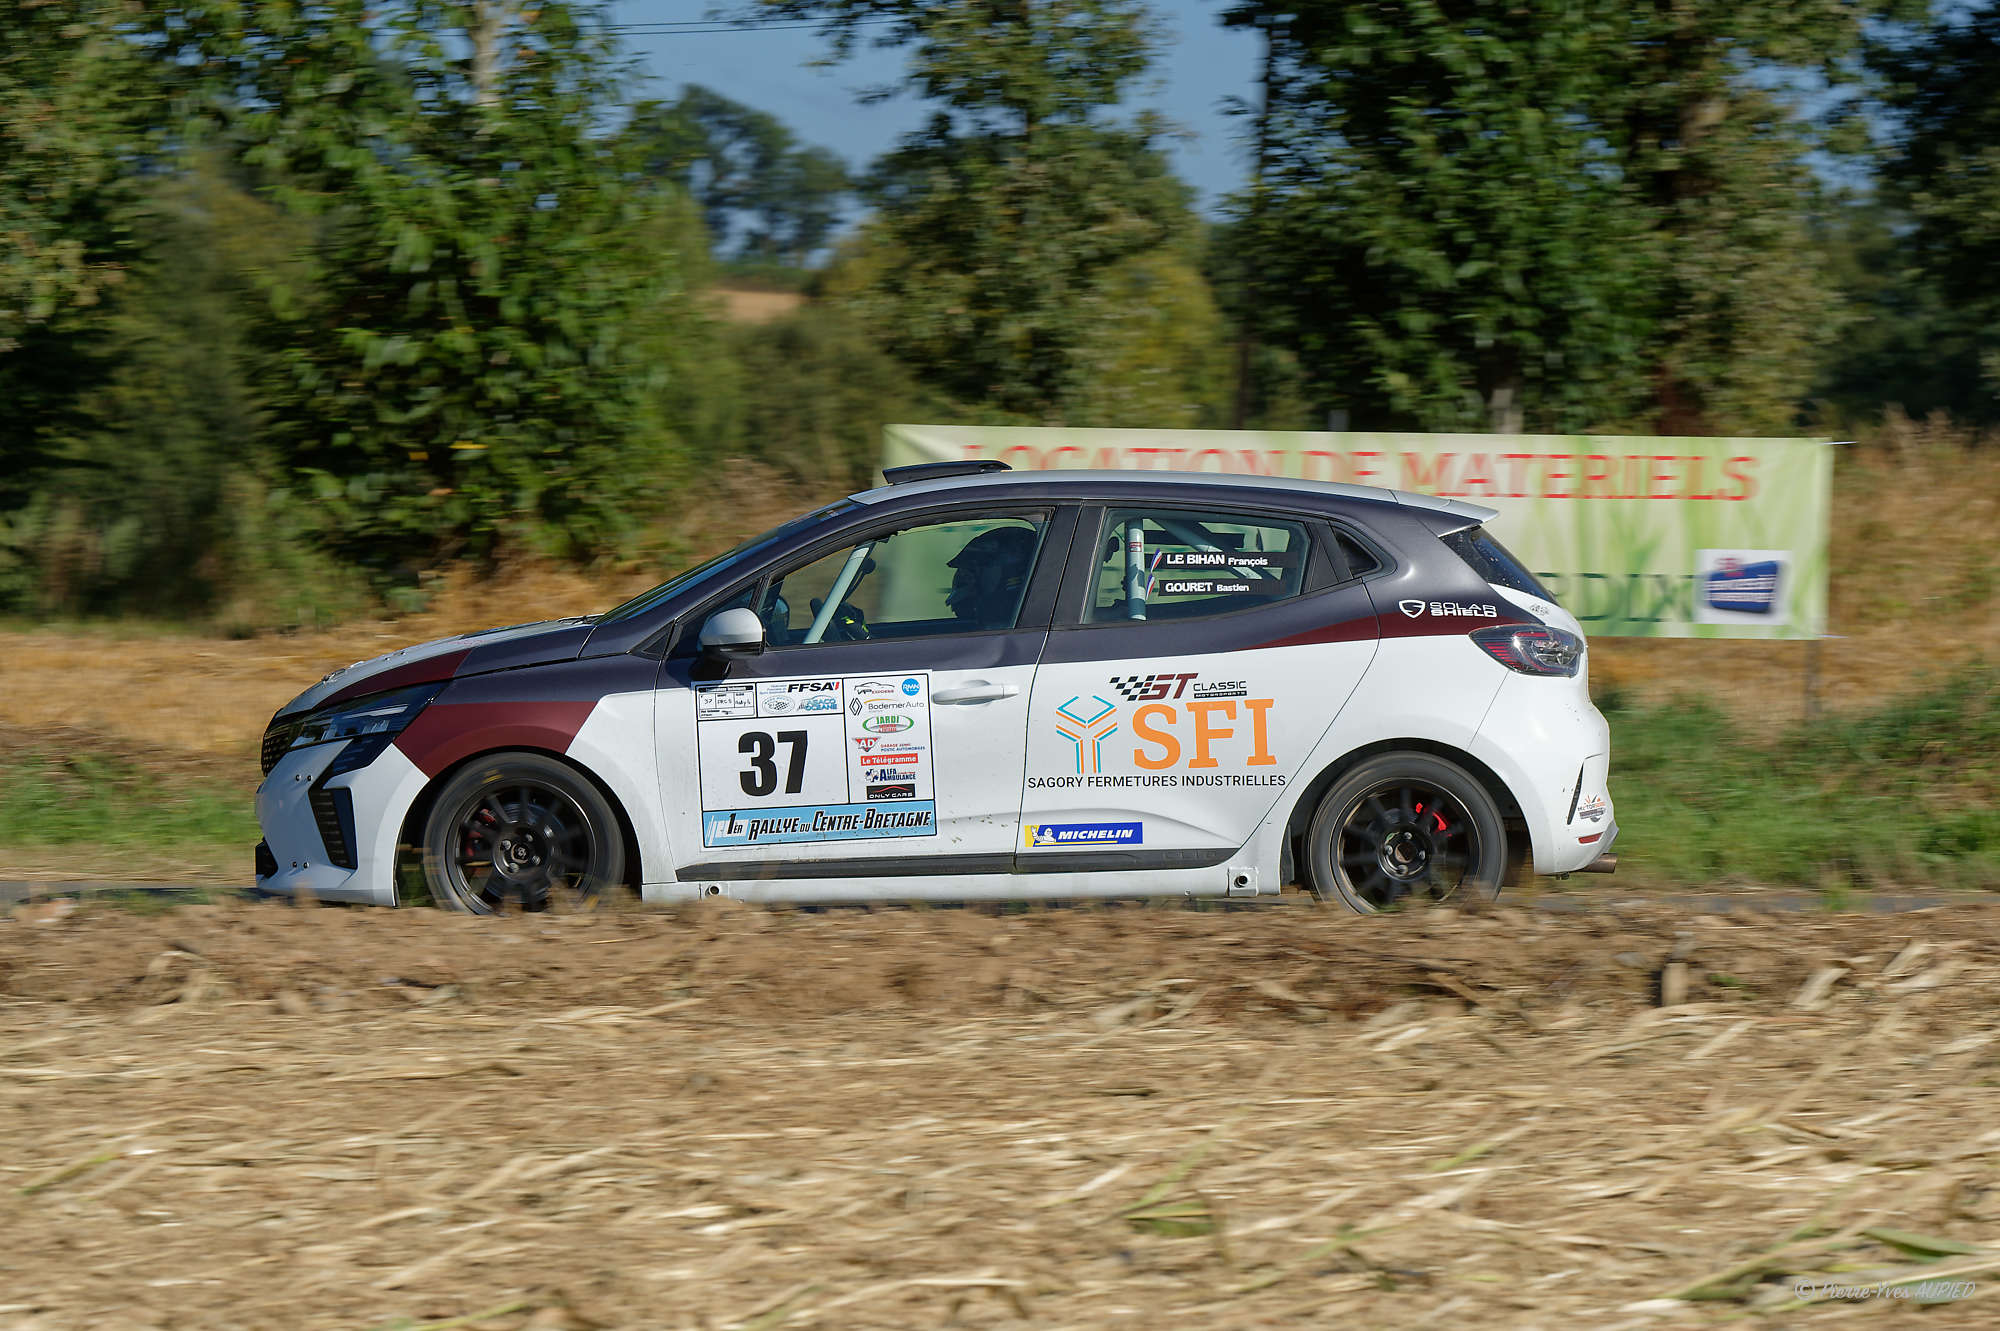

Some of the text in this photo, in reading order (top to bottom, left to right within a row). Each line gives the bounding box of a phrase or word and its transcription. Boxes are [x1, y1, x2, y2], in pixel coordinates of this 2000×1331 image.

[1302, 450, 1385, 486] DE
[1400, 452, 1759, 501] MATERIELS
[1166, 554, 1268, 567] LE BIHAN François
[1165, 582, 1250, 592] GOURET Bastien
[1430, 602, 1497, 612] SOLAR
[1430, 608, 1498, 618] SHIELD
[788, 682, 834, 693] FFSA
[1193, 681, 1247, 691] CLASSIC
[876, 715, 900, 724] JARDI
[1132, 698, 1277, 770] SFI
[860, 739, 875, 748] AD
[738, 730, 808, 797] 37
[872, 756, 917, 765] Télégramme
[1028, 774, 1286, 788] SAGORY FERMETURES INDUSTRIELLES
[749, 818, 800, 840] RALLYE
[812, 808, 932, 832] CENTRE-BRETAGNE
[1058, 829, 1134, 841] MICHELIN
